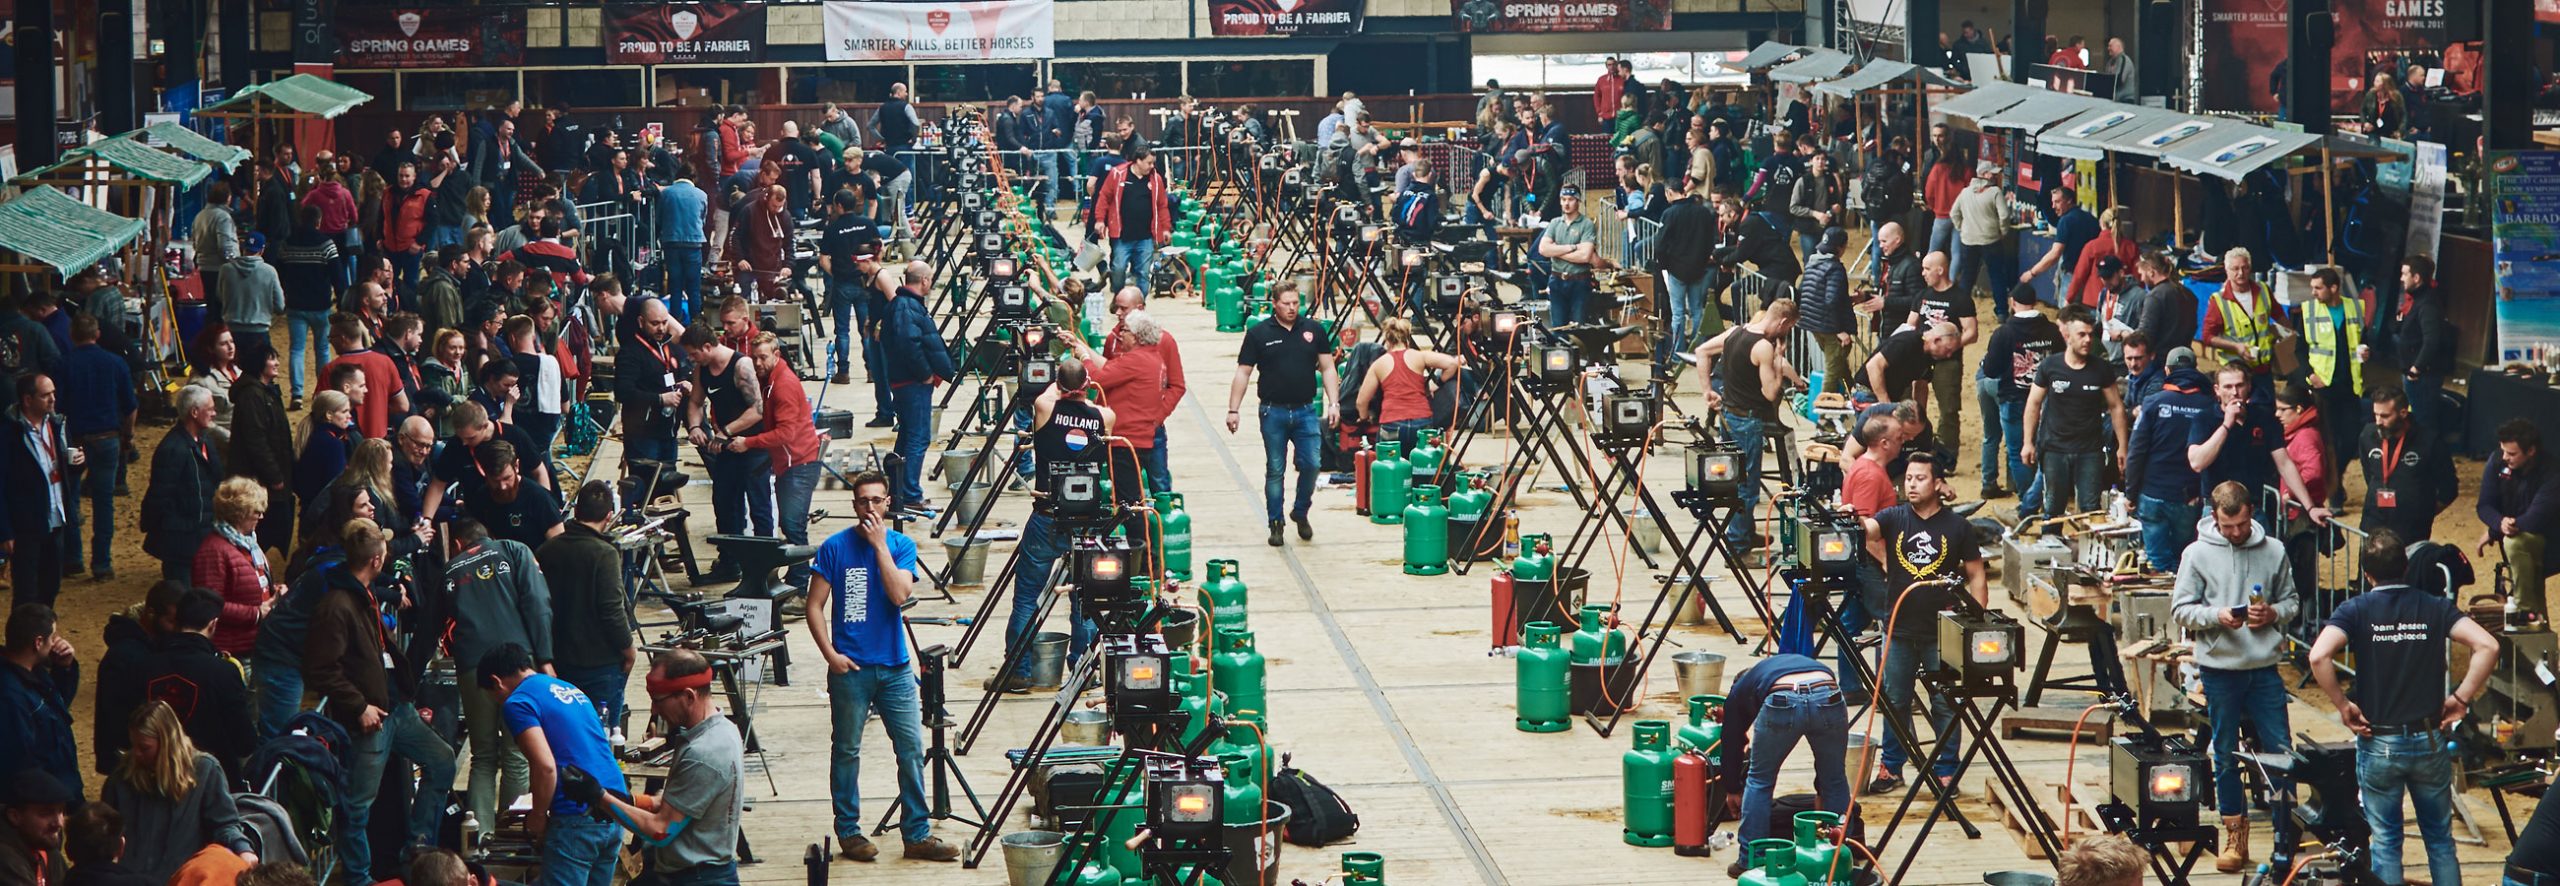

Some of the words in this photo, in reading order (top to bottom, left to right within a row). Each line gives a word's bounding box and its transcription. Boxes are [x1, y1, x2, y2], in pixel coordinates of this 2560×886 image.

[1504, 3, 1560, 18] SPRING
[1564, 3, 1618, 17] GAMES
[2385, 0, 2445, 17] GAMES
[1223, 13, 1259, 25] PROUD
[1262, 13, 1275, 25] TO
[1278, 13, 1293, 25] BE
[1295, 13, 1303, 25] A
[1306, 12, 1351, 24] FARRIER
[2405, 20, 2426, 28] APRIL
[350, 39, 409, 53] SPRING
[413, 39, 471, 52] GAMES
[620, 41, 657, 53] PROUD
[660, 41, 673, 53] TO
[676, 41, 691, 52] BE
[693, 41, 702, 53] A
[704, 40, 751, 52] FARRIER
[844, 38, 896, 51] SMARTER
[900, 38, 941, 51] SKILLS,
[945, 37, 987, 50] BETTER
[990, 36, 1035, 49] HORSES
[2505, 213, 2560, 225] BARBAD
[1055, 413, 1100, 430] HOLLAND
[845, 567, 857, 593] SHOES
[855, 567, 867, 622] HANDMADE
[739, 603, 758, 612] Arjan
[844, 593, 856, 623] FRANCE
[743, 612, 755, 620] Kin
